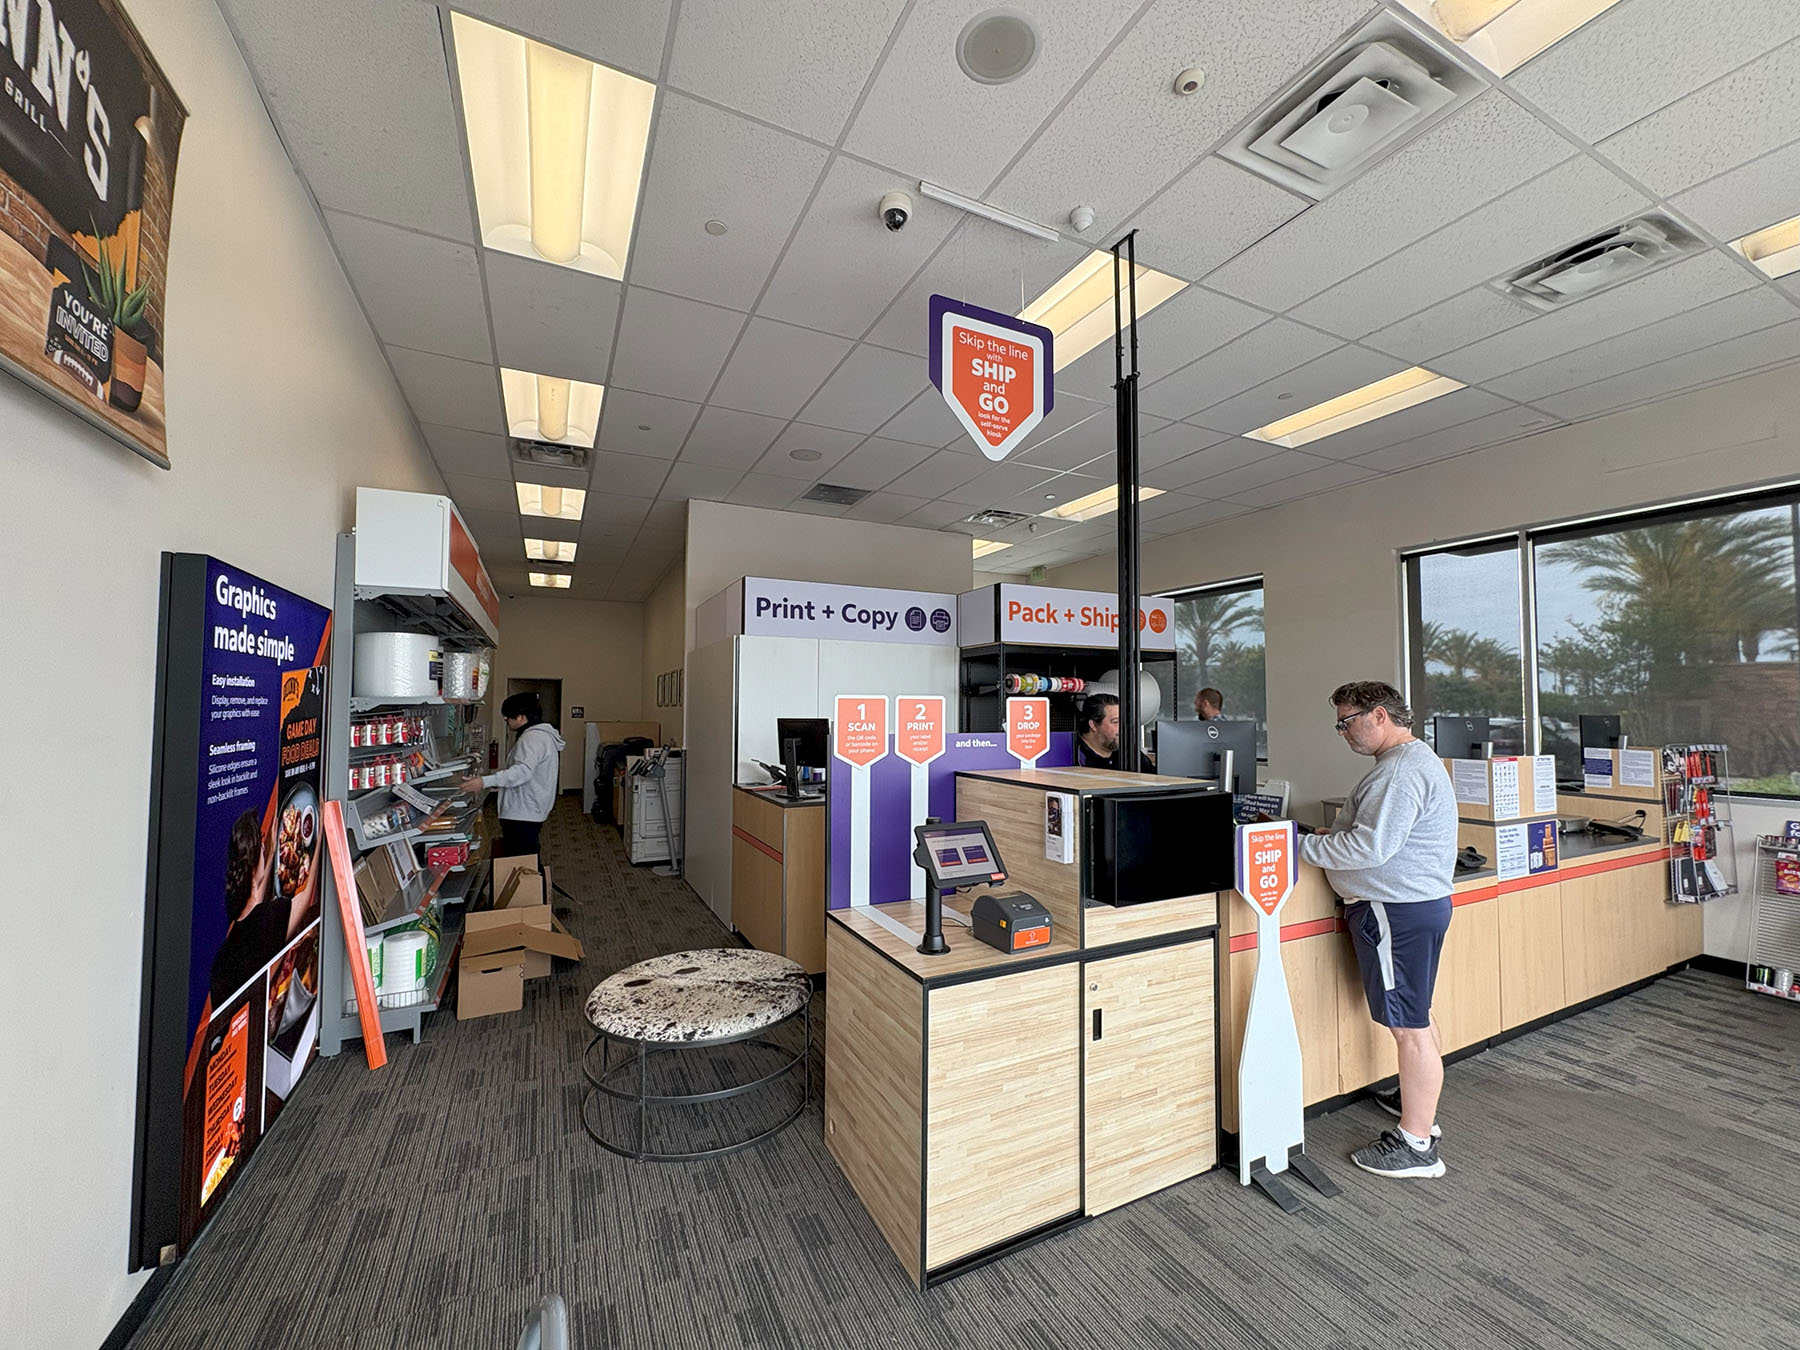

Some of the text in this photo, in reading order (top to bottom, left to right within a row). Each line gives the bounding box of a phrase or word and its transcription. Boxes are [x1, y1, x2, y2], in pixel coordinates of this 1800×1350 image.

[5, 76, 47, 133] GRILL
[64, 289, 108, 340] YOU'RE
[55, 305, 109, 362] INVITED
[959, 331, 1028, 361] Skip the line
[986, 353, 1003, 363] with
[971, 358, 1016, 384] SHIP
[983, 382, 1006, 395] and
[978, 393, 1009, 414] GO
[978, 411, 1011, 424] look for the
[980, 420, 1009, 431] self-serve
[215, 574, 277, 620] Graphics
[756, 597, 898, 631] Print + Copy
[1008, 601, 1119, 633] Pack + Ship
[214, 624, 295, 666] made simple
[212, 674, 226, 688] Easy
[210, 711, 222, 721] your
[856, 703, 866, 721] 1
[915, 703, 926, 720] 2
[1024, 705, 1033, 720] 3
[286, 718, 318, 740] GAME DAY
[847, 722, 876, 732] SCAN
[906, 722, 934, 731] PRINT
[1017, 722, 1040, 730] DROP
[209, 739, 256, 756] Seamless framing
[955, 739, 997, 748] and then...
[1251, 832, 1285, 844] Skip the line
[1255, 849, 1282, 864] SHIP
[1262, 864, 1276, 873] and
[1260, 875, 1278, 888] GO
[209, 1043, 232, 1073] MONDAY
[208, 1064, 231, 1093] TUESDAY
[208, 1075, 239, 1116] WEDNESDAY
[207, 1101, 234, 1136] THURSDAY
[206, 1131, 225, 1159] FRIDAY
